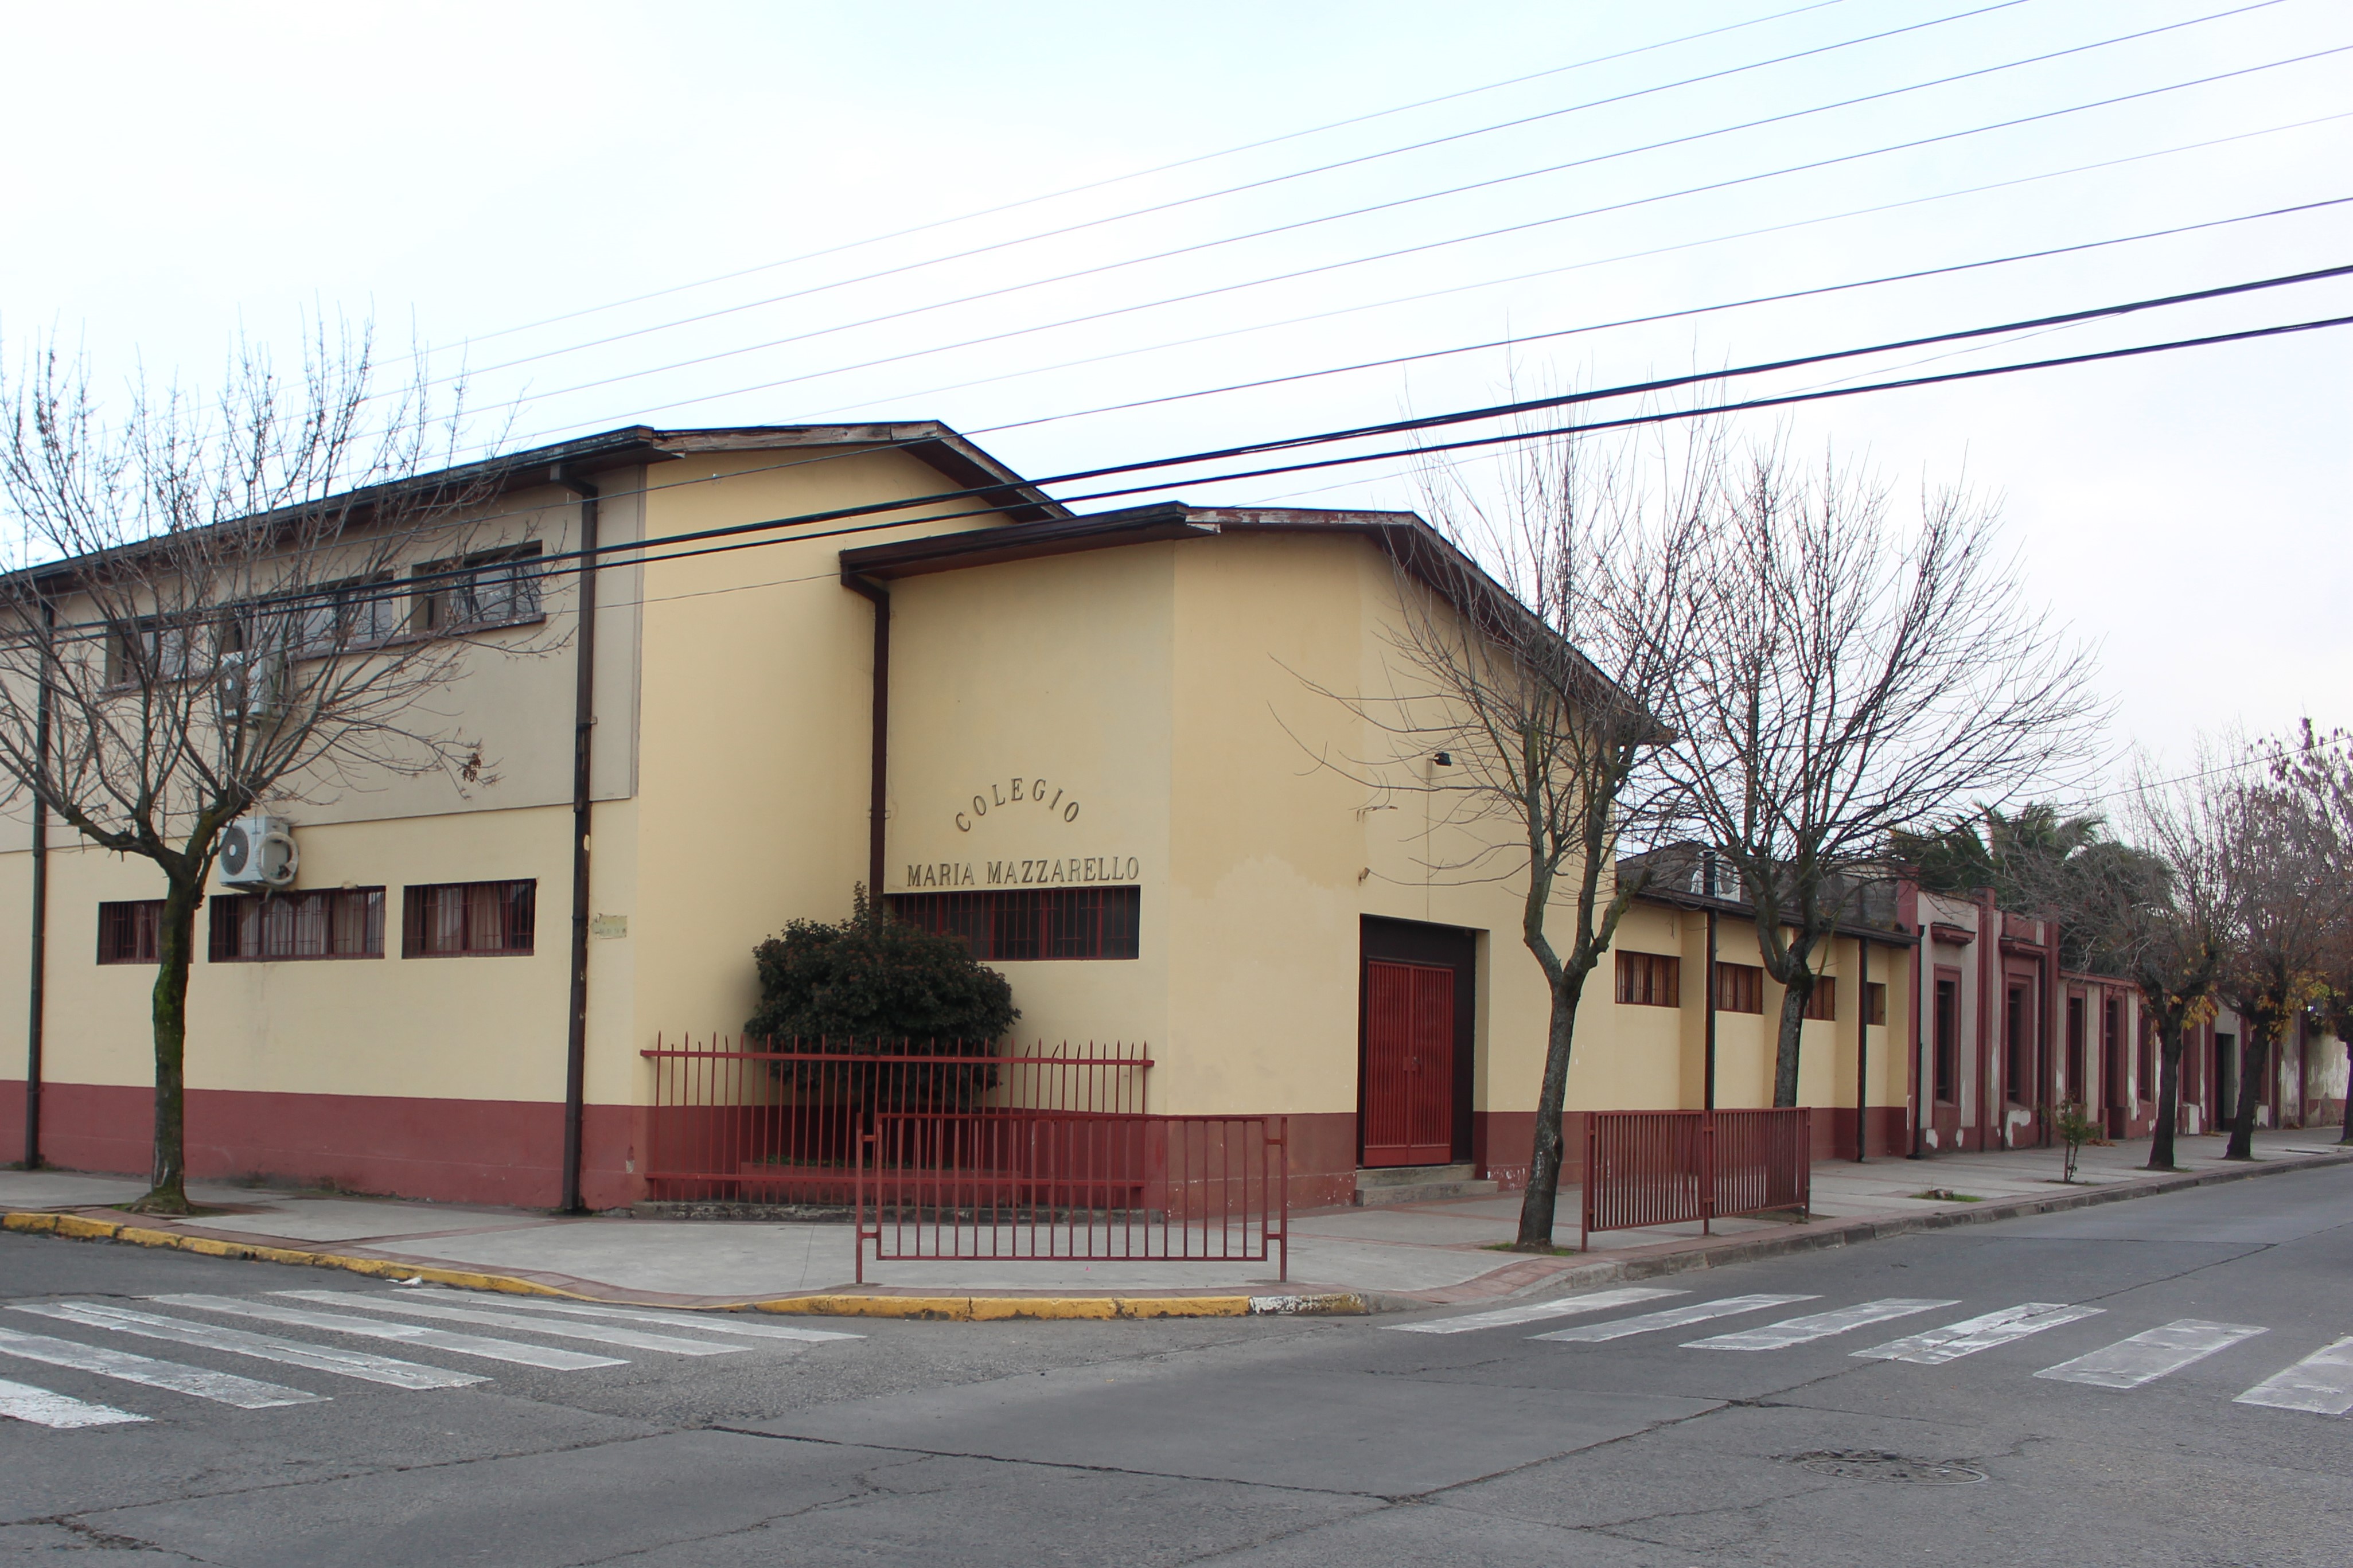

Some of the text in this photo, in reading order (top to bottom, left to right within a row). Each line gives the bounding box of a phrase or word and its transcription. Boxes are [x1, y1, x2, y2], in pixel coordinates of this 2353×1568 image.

[956, 778, 1080, 832] COLEGIO
[907, 856, 1139, 887] MARIA MAZZARELLO
